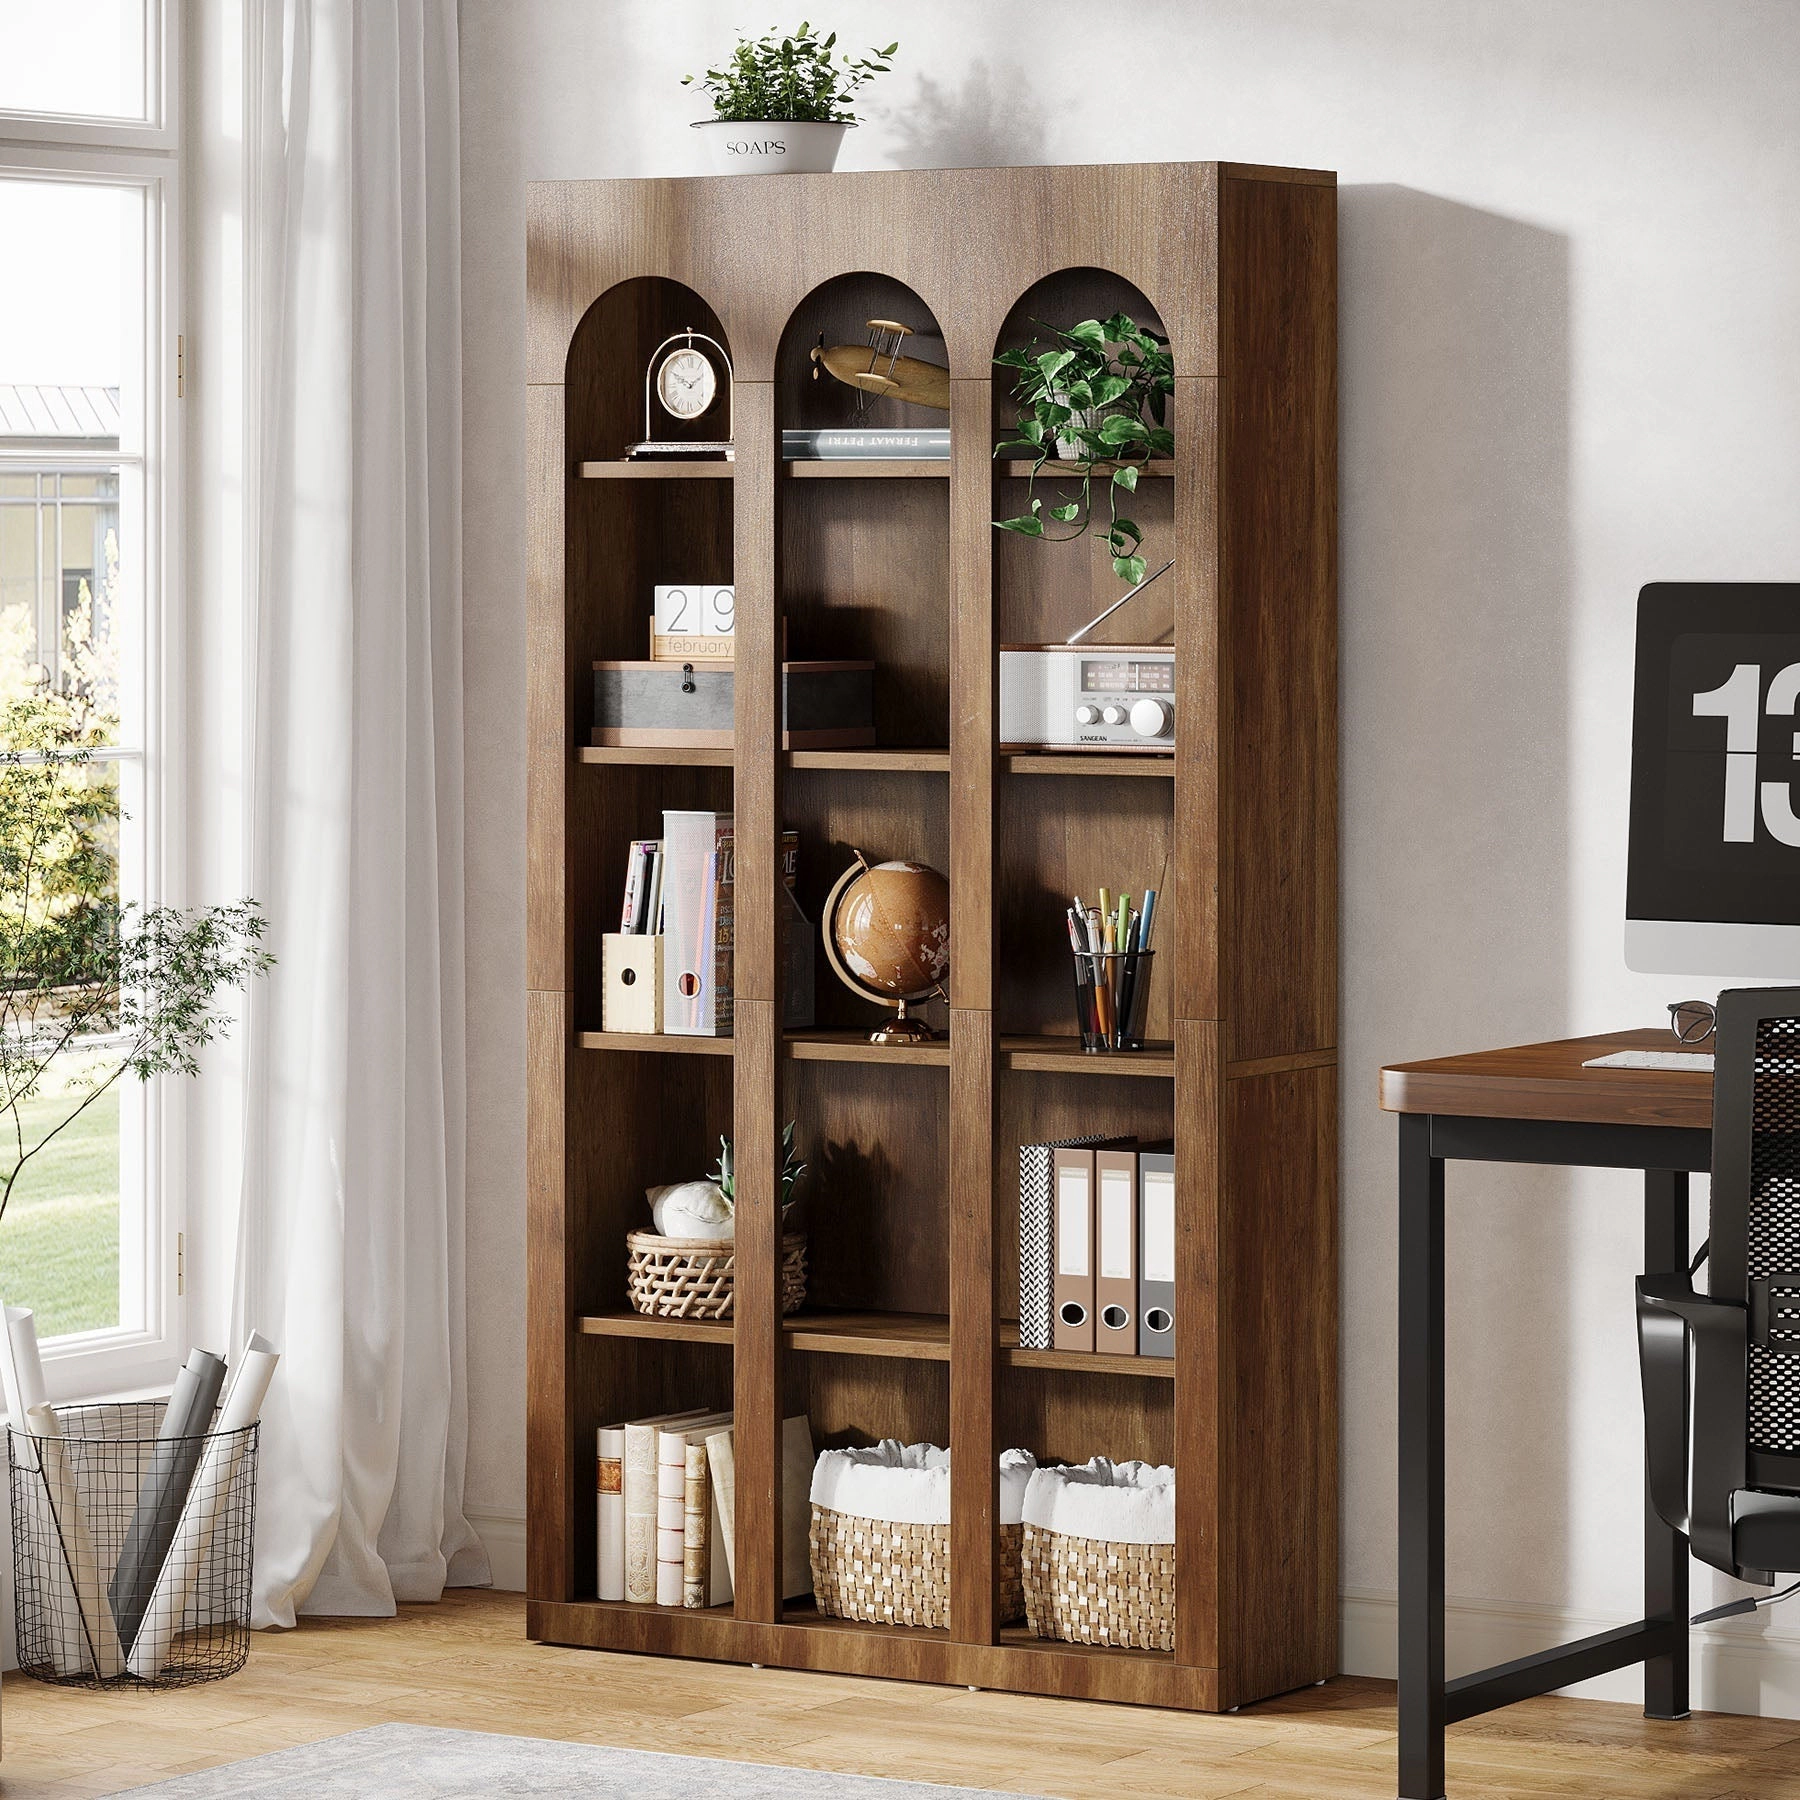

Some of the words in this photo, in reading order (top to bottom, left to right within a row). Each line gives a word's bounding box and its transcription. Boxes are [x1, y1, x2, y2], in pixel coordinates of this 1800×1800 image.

[726, 141, 786, 155] SOAPS
[869, 436, 919, 447] FERMAT
[666, 589, 734, 633] 29
[668, 637, 732, 657] february
